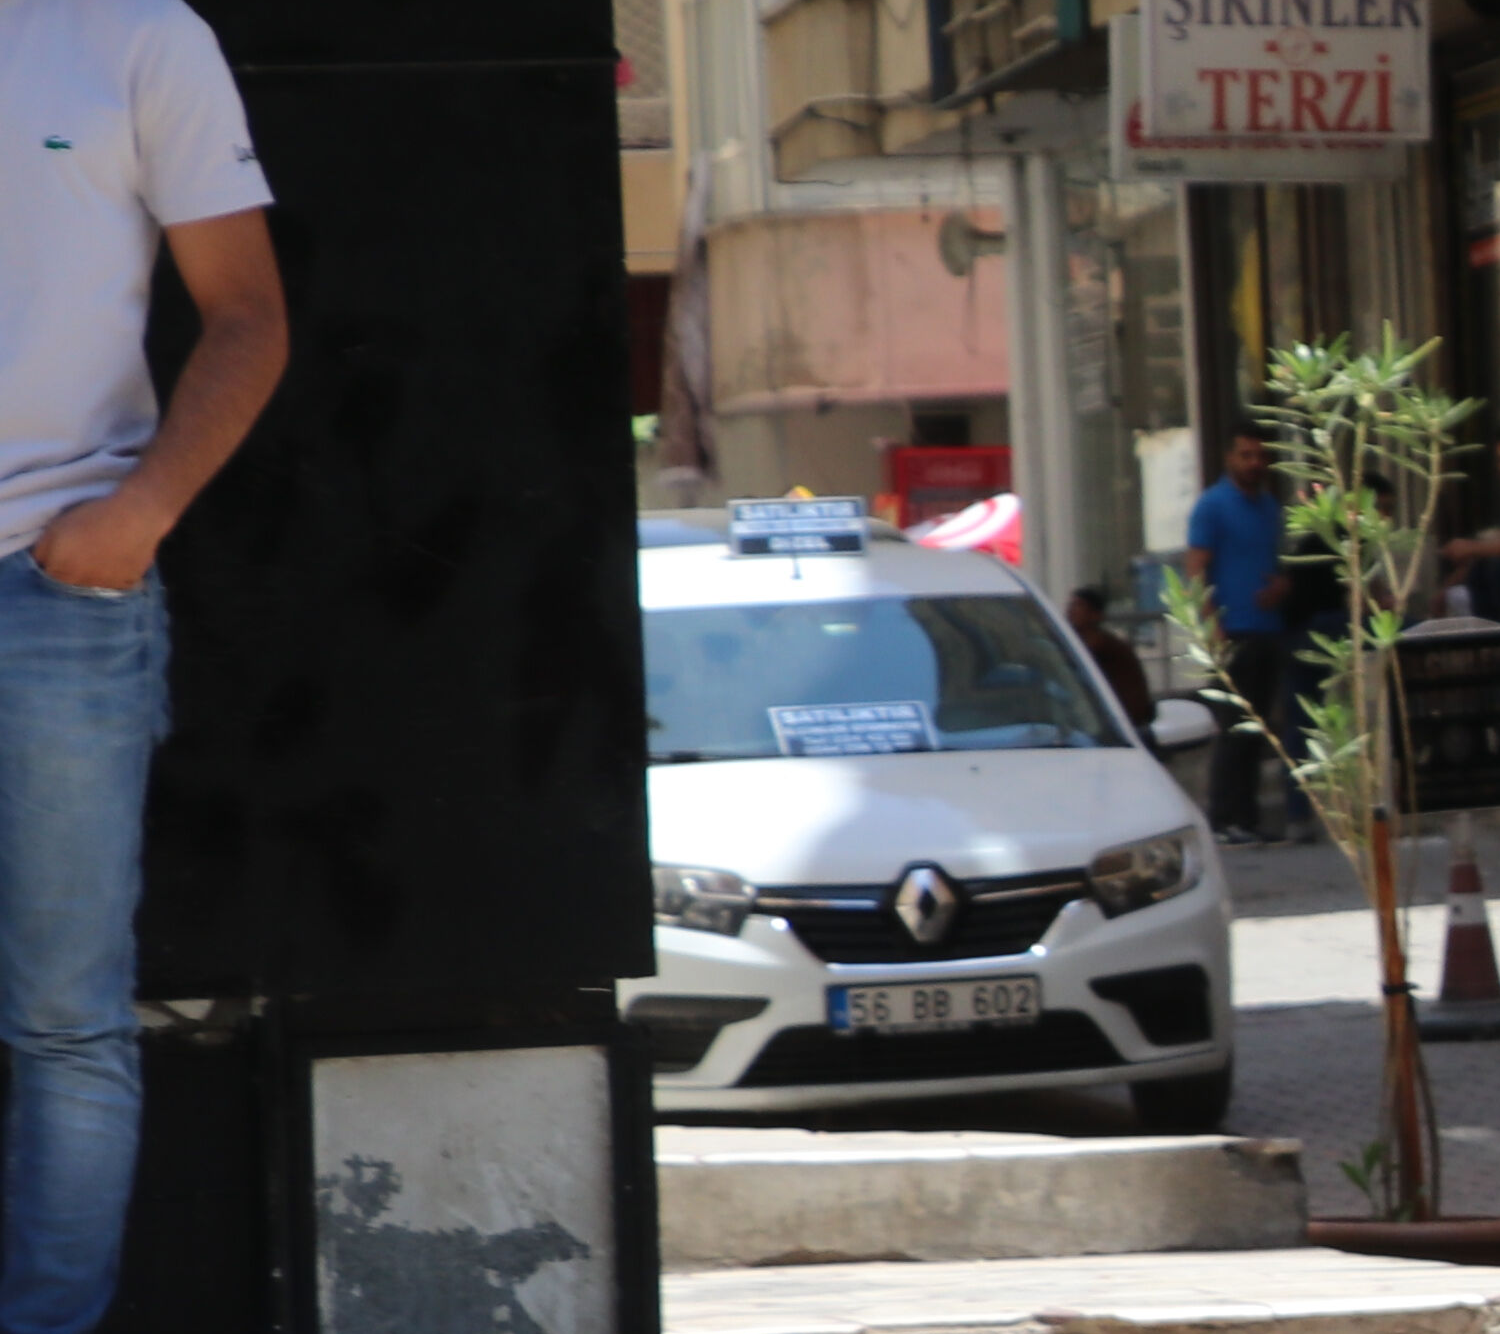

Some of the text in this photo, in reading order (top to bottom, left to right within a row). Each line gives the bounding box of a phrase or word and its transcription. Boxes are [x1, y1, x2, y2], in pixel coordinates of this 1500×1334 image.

[1198, 55, 1394, 133] TERZİ
[851, 991, 890, 1024] 56
[973, 984, 1032, 1016] 602
